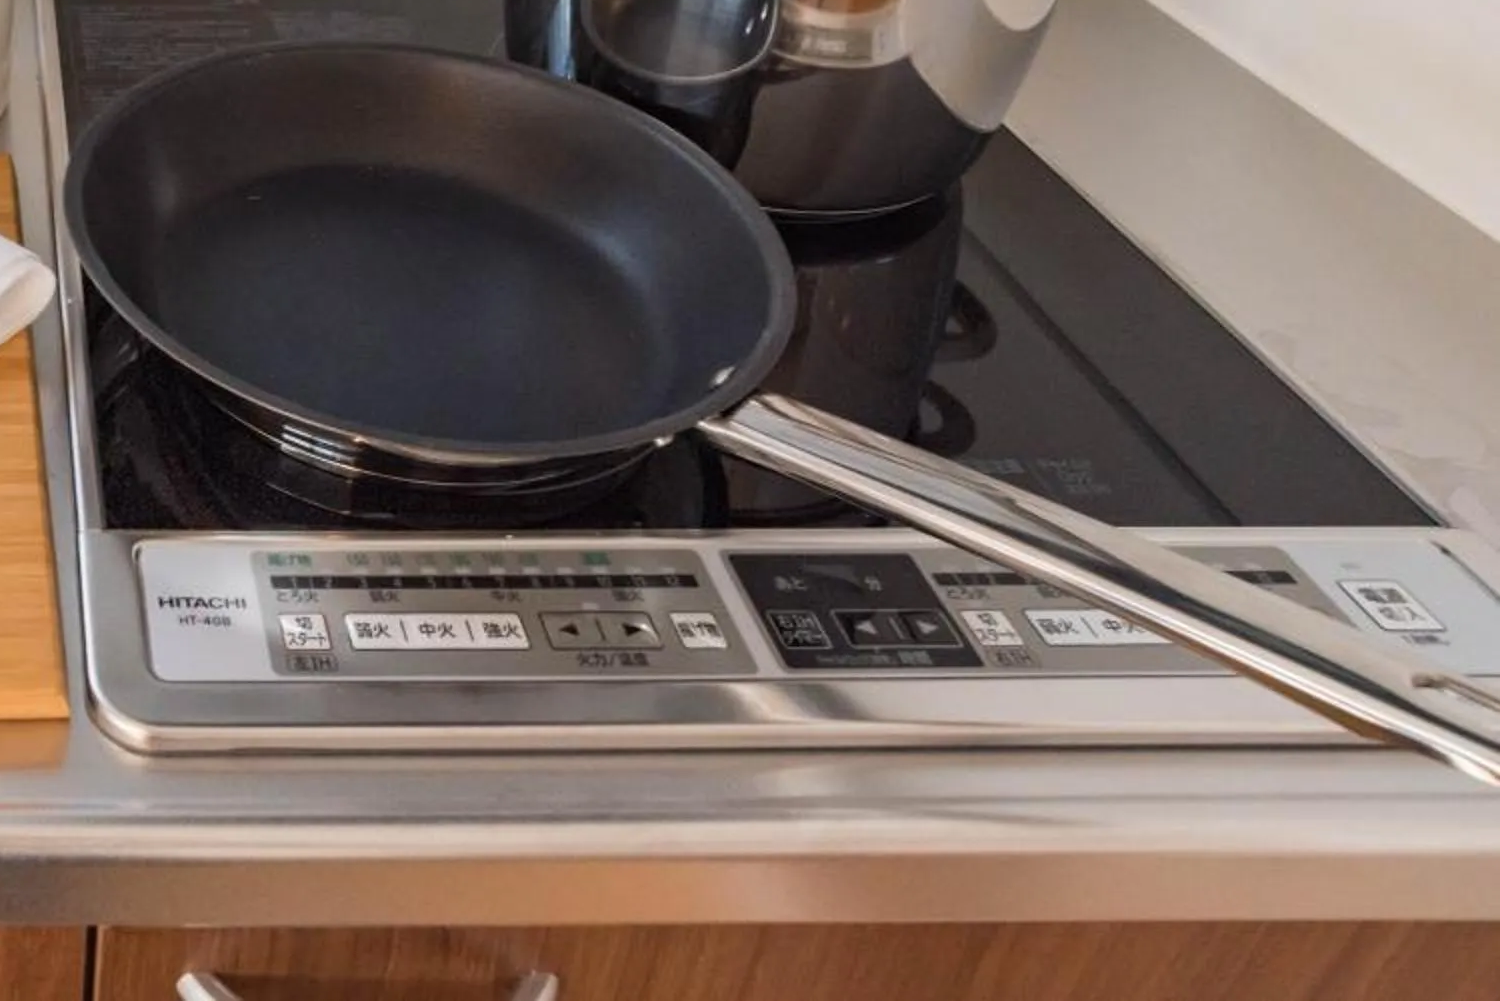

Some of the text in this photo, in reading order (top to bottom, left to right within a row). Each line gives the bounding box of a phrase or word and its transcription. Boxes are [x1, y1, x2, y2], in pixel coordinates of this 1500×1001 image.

[157, 596, 248, 610] HITACHI
[418, 622, 457, 638] 中火
[482, 621, 522, 639] 強火
